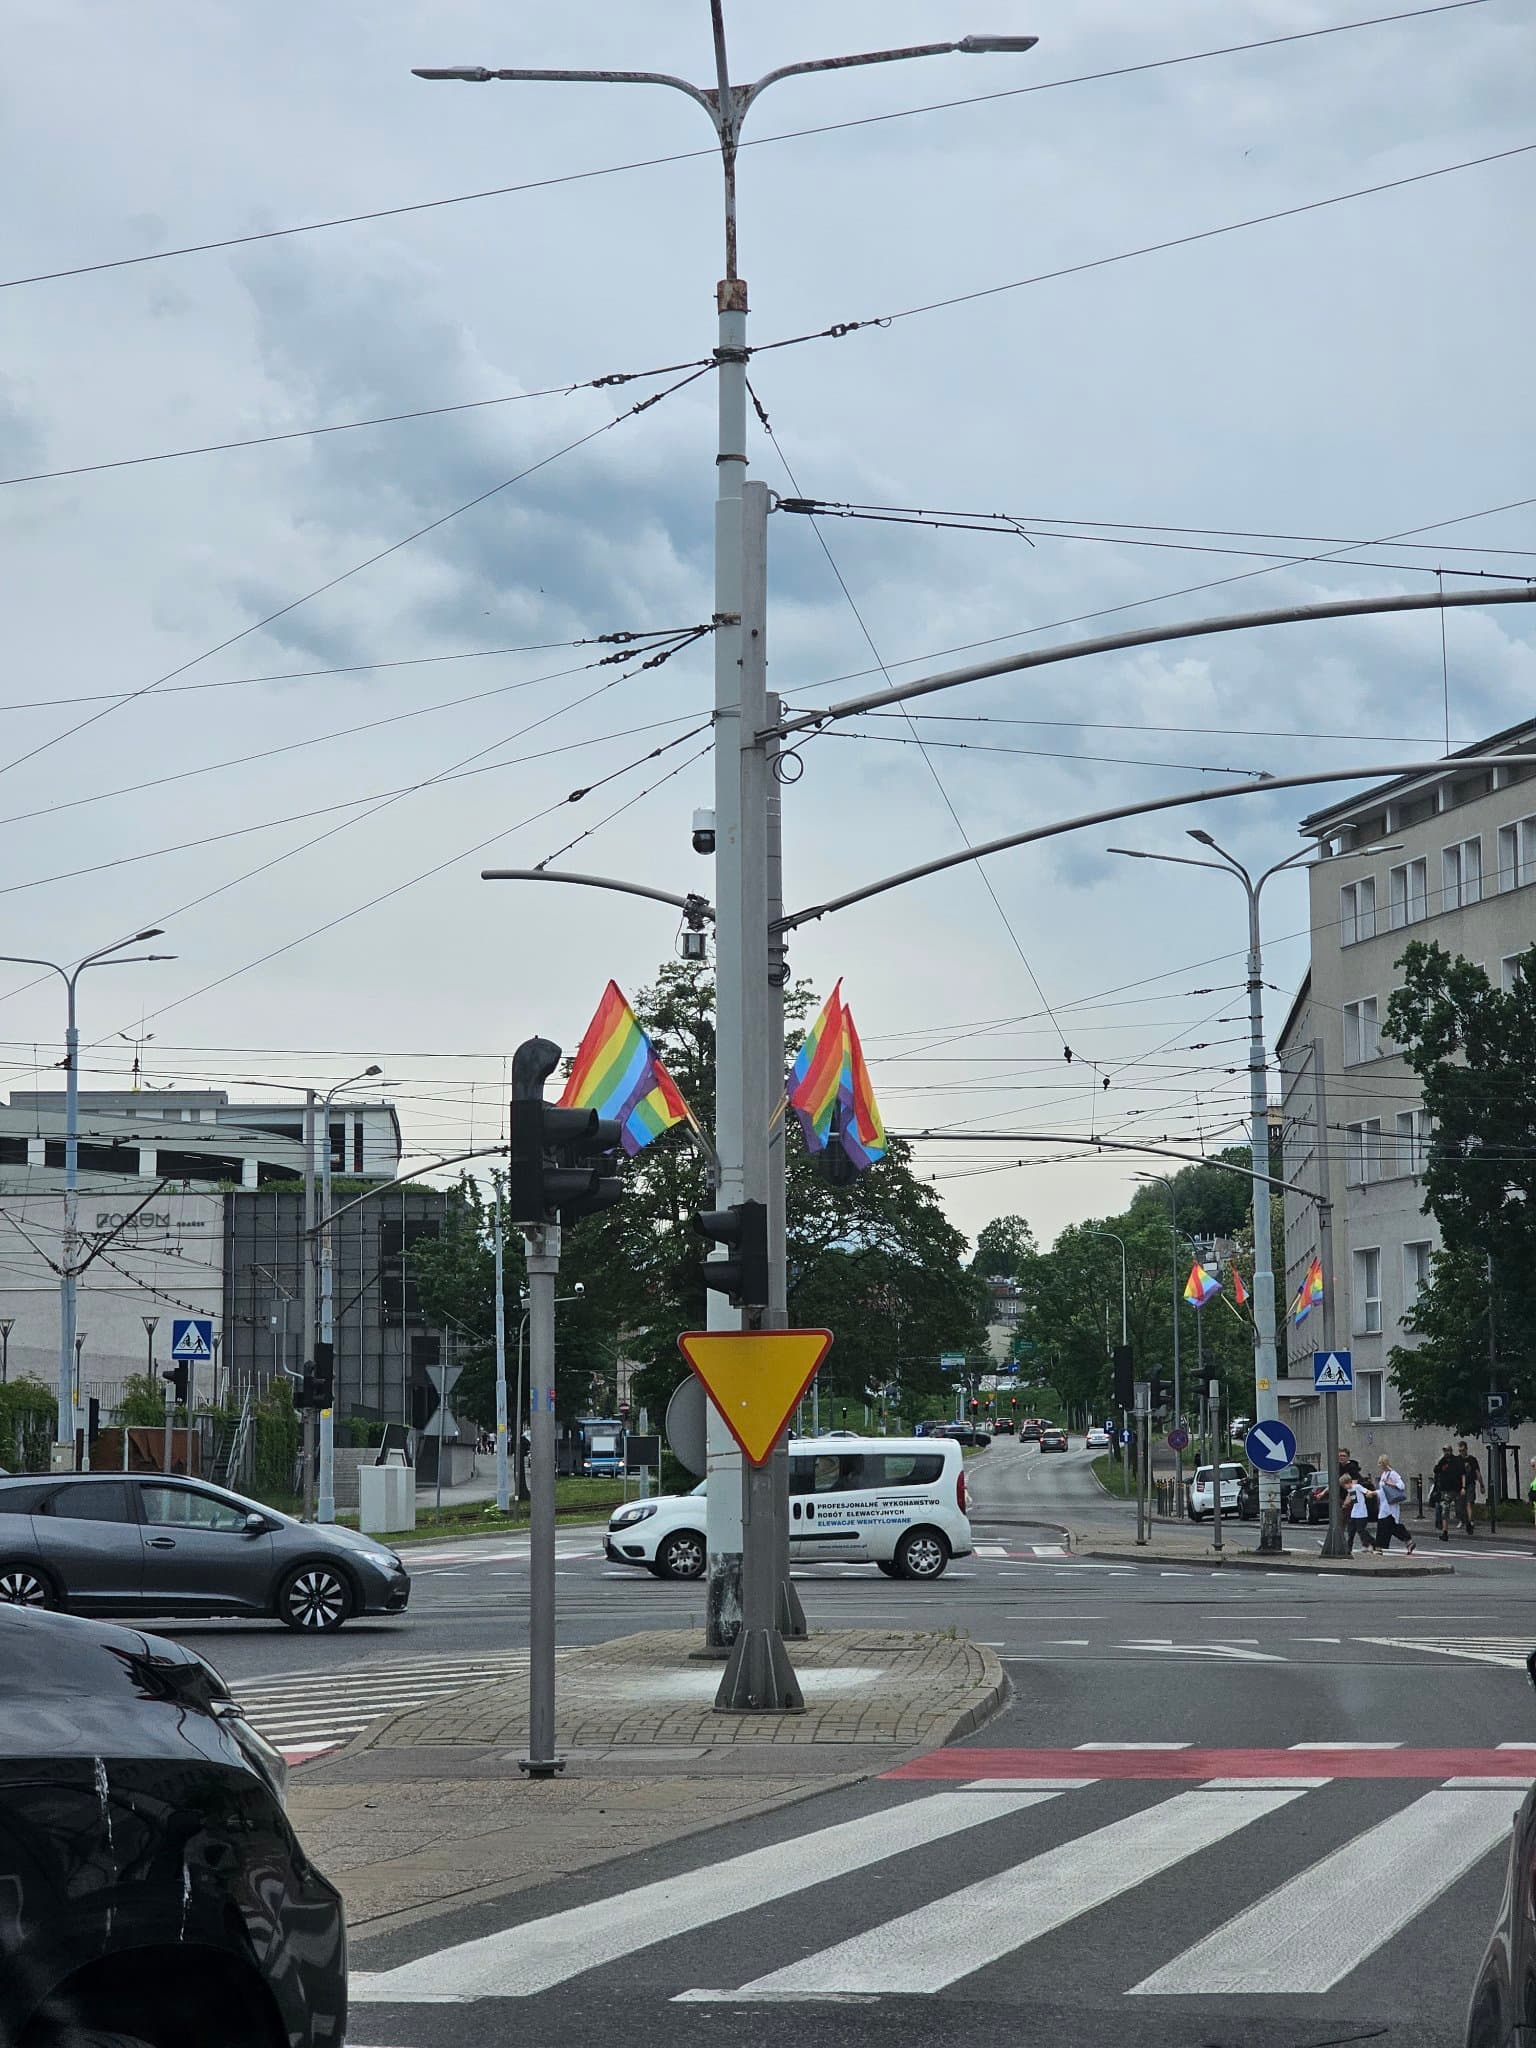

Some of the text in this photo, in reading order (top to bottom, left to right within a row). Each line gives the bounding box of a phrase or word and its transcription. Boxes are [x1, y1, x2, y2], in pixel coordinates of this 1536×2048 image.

[817, 1499, 940, 1509] PROFESJONALNE WYKONAWSTWO
[817, 1509, 905, 1518] ROBÓT ELEWACYJNYCH
[817, 1517, 911, 1527] ELEWACJE WENTYLOWANE
